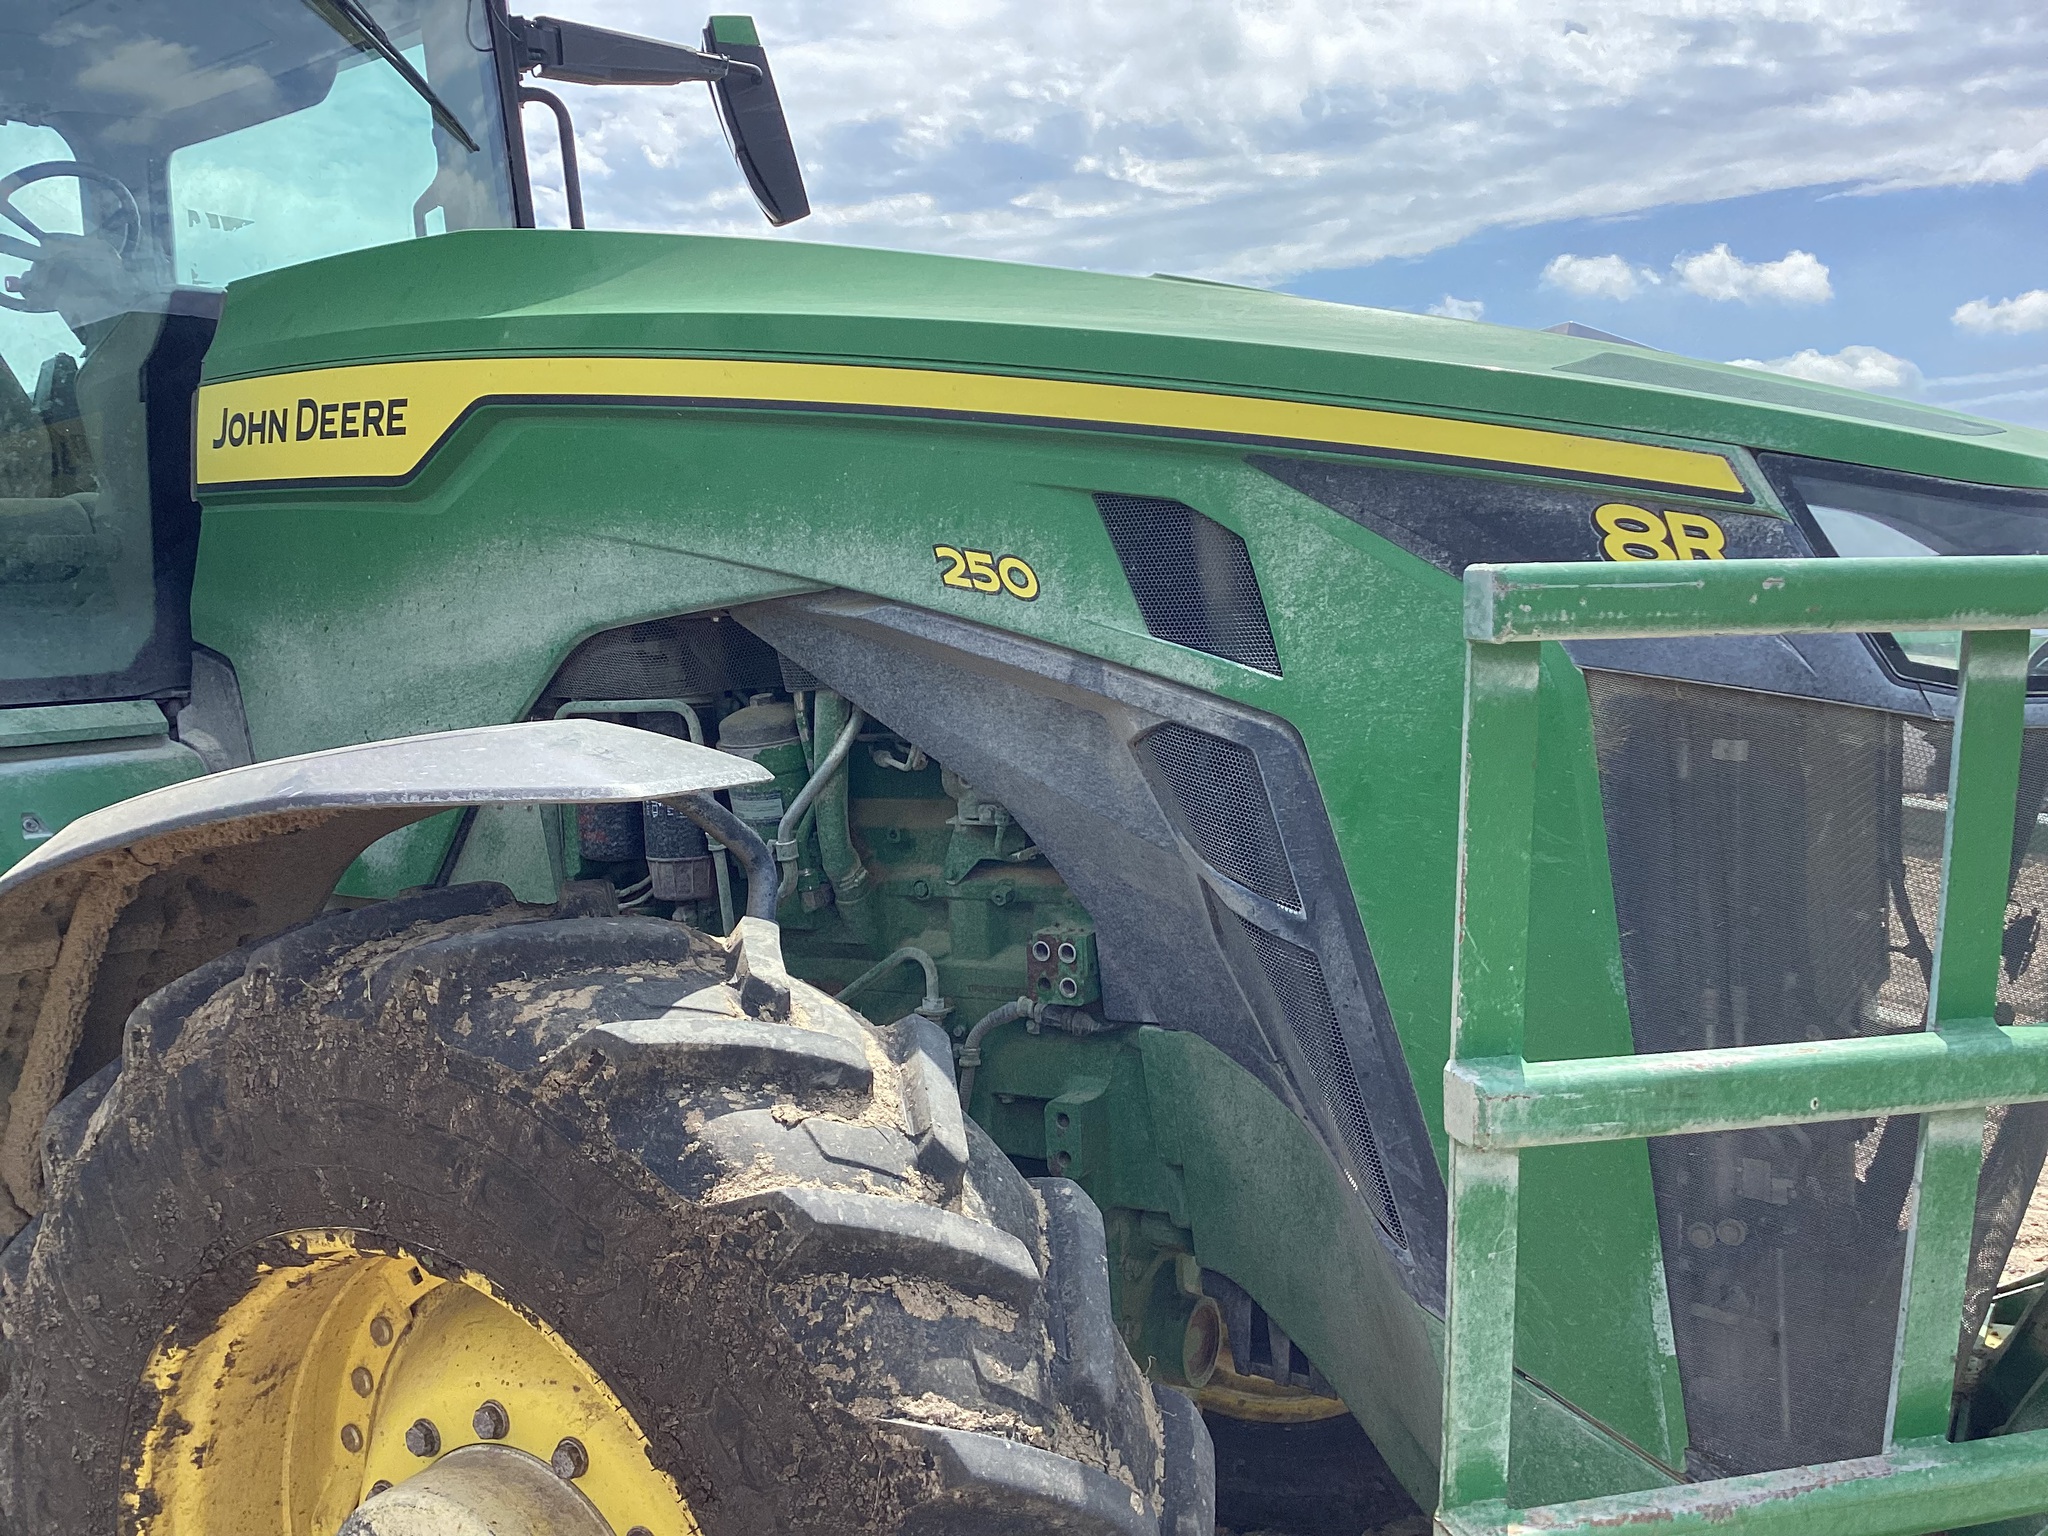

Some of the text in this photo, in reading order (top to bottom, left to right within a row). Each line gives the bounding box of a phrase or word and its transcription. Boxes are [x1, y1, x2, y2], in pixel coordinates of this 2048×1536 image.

[212, 398, 408, 448] JOHN DEERE
[1592, 503, 1726, 561] 8R
[933, 543, 1041, 602] 250
